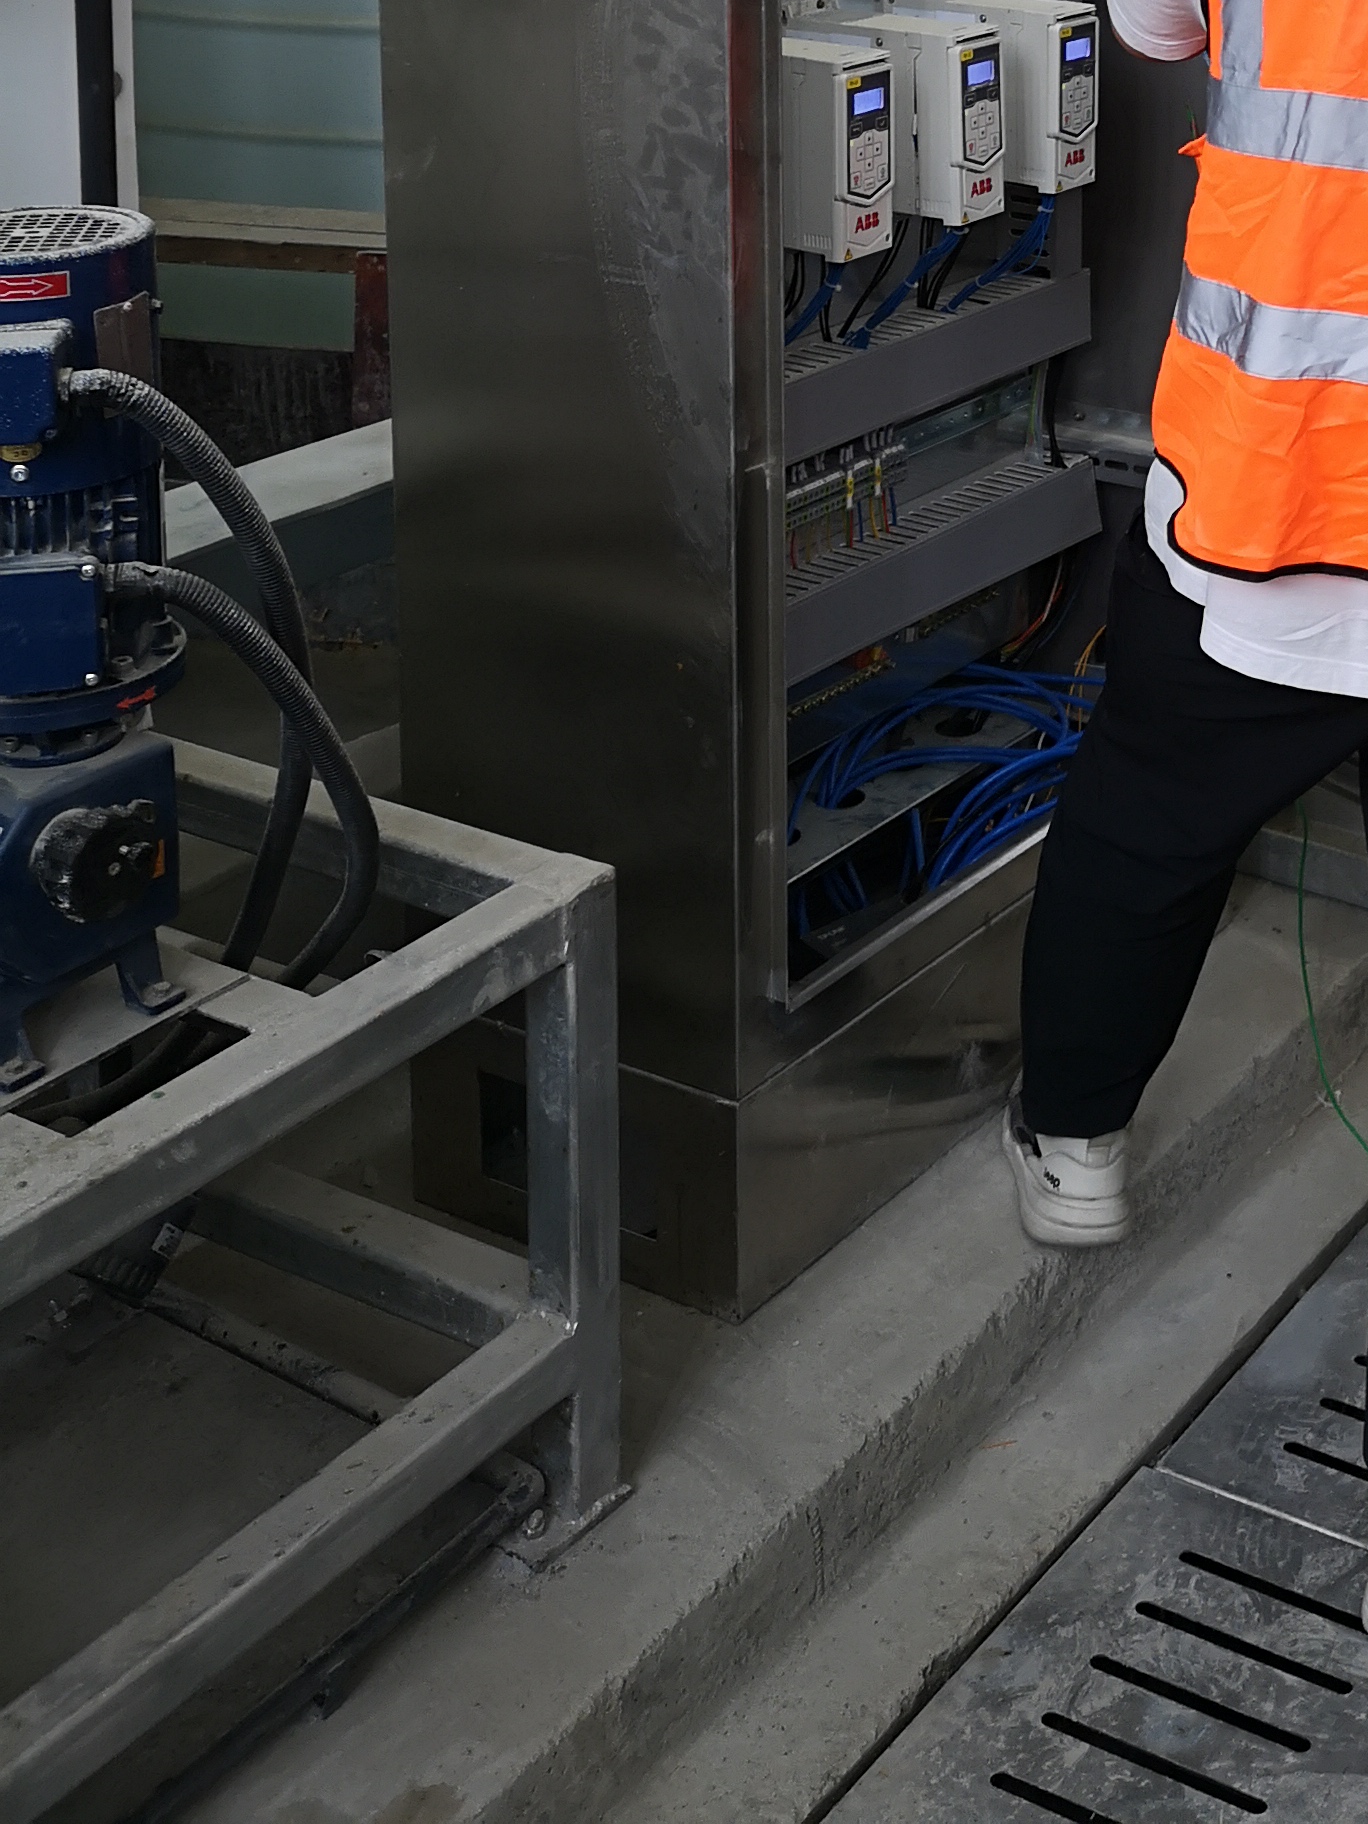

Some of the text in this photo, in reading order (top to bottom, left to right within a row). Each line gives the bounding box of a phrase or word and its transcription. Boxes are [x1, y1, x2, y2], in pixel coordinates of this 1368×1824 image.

[1065, 148, 1085, 167] ABB
[970, 177, 993, 198] ABB
[854, 211, 880, 233] ABB
